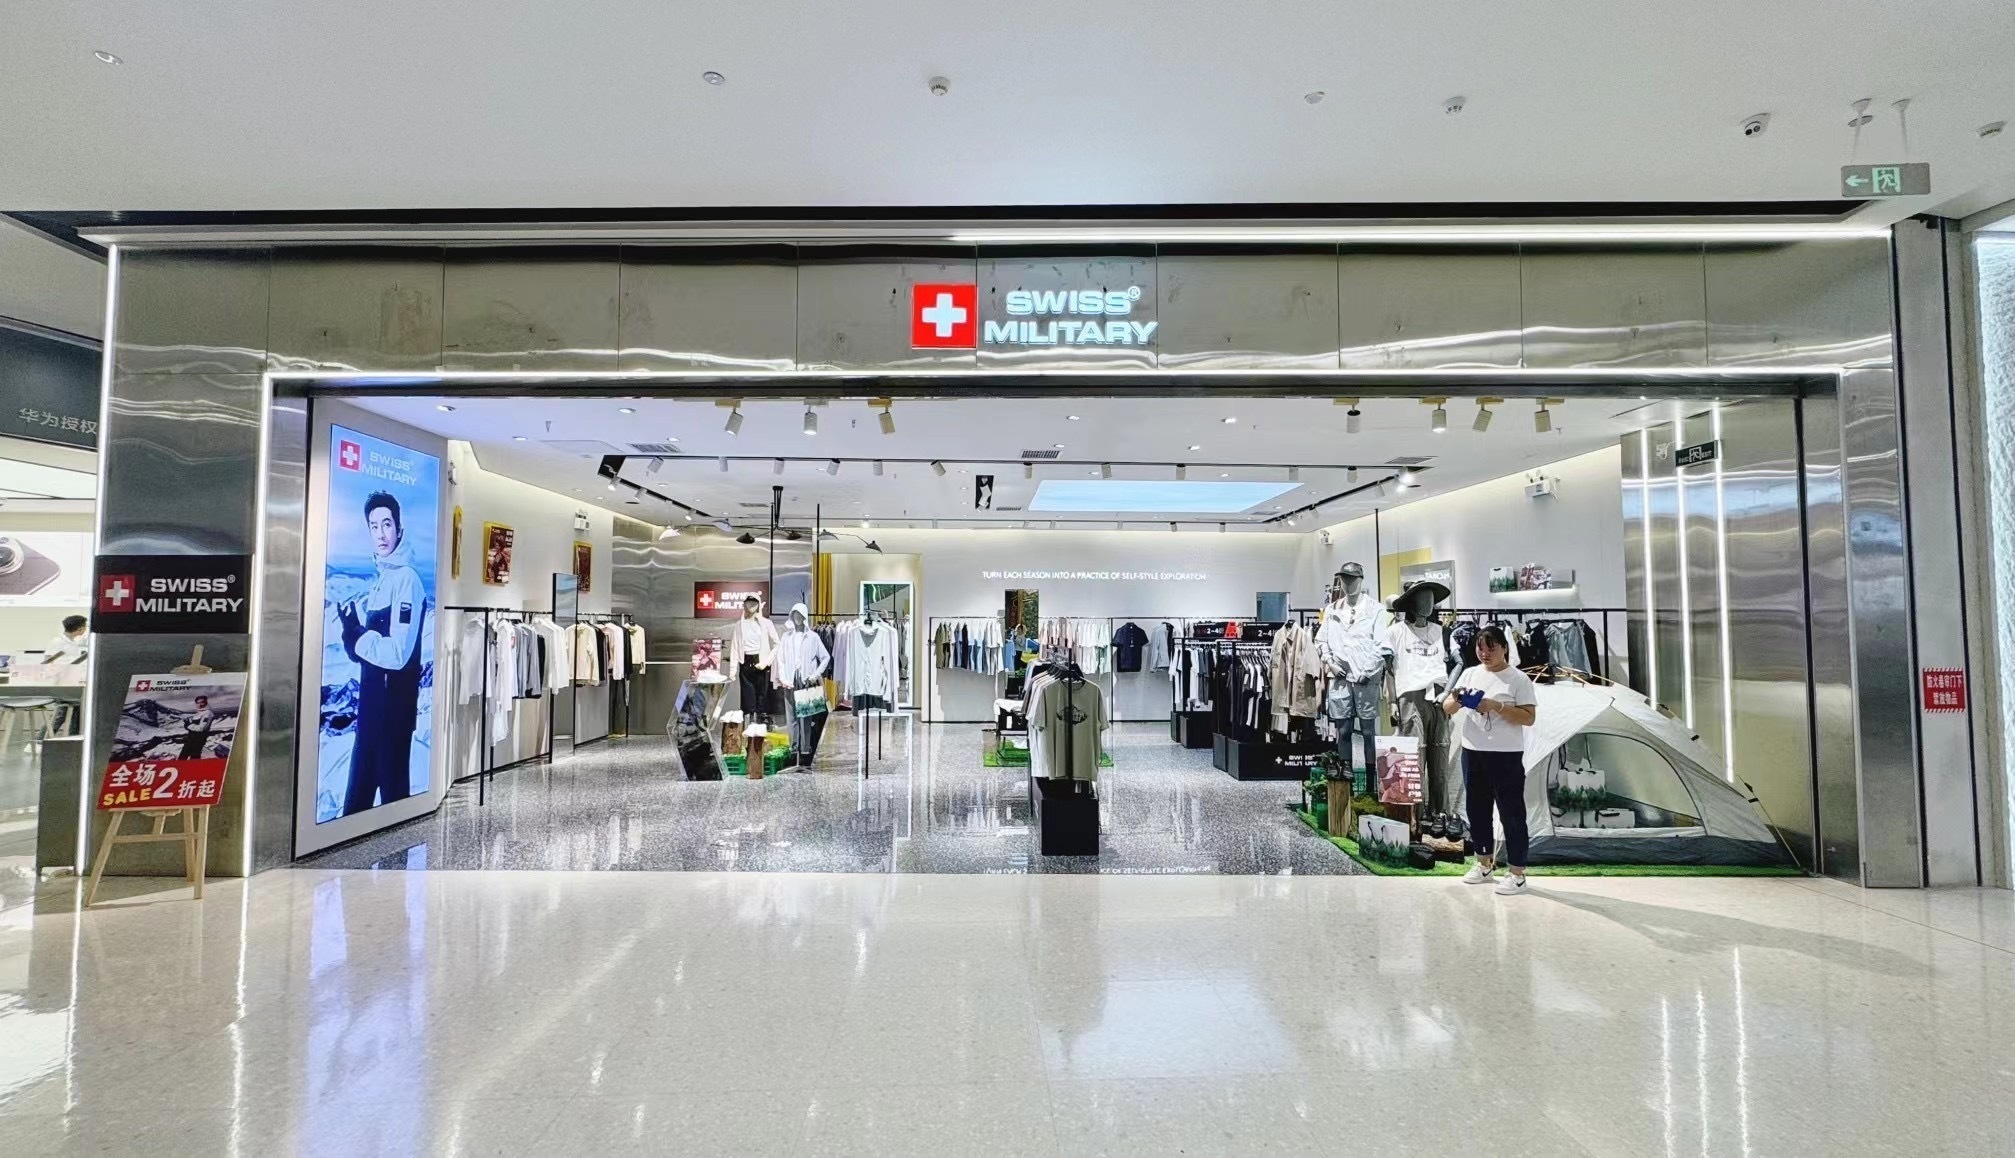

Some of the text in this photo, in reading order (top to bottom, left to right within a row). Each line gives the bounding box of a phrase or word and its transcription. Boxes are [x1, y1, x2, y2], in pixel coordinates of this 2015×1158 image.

[984, 320, 1159, 345] MILITARY
[19, 408, 97, 434] 华为授权
[361, 464, 417, 486] MILITARY
[982, 571, 1206, 580] TURN EACH SEASON INTO A PRACTICE OF SELF-STYLE EXPLORATION
[135, 598, 244, 613] MILITARY
[103, 787, 152, 806] SALE
